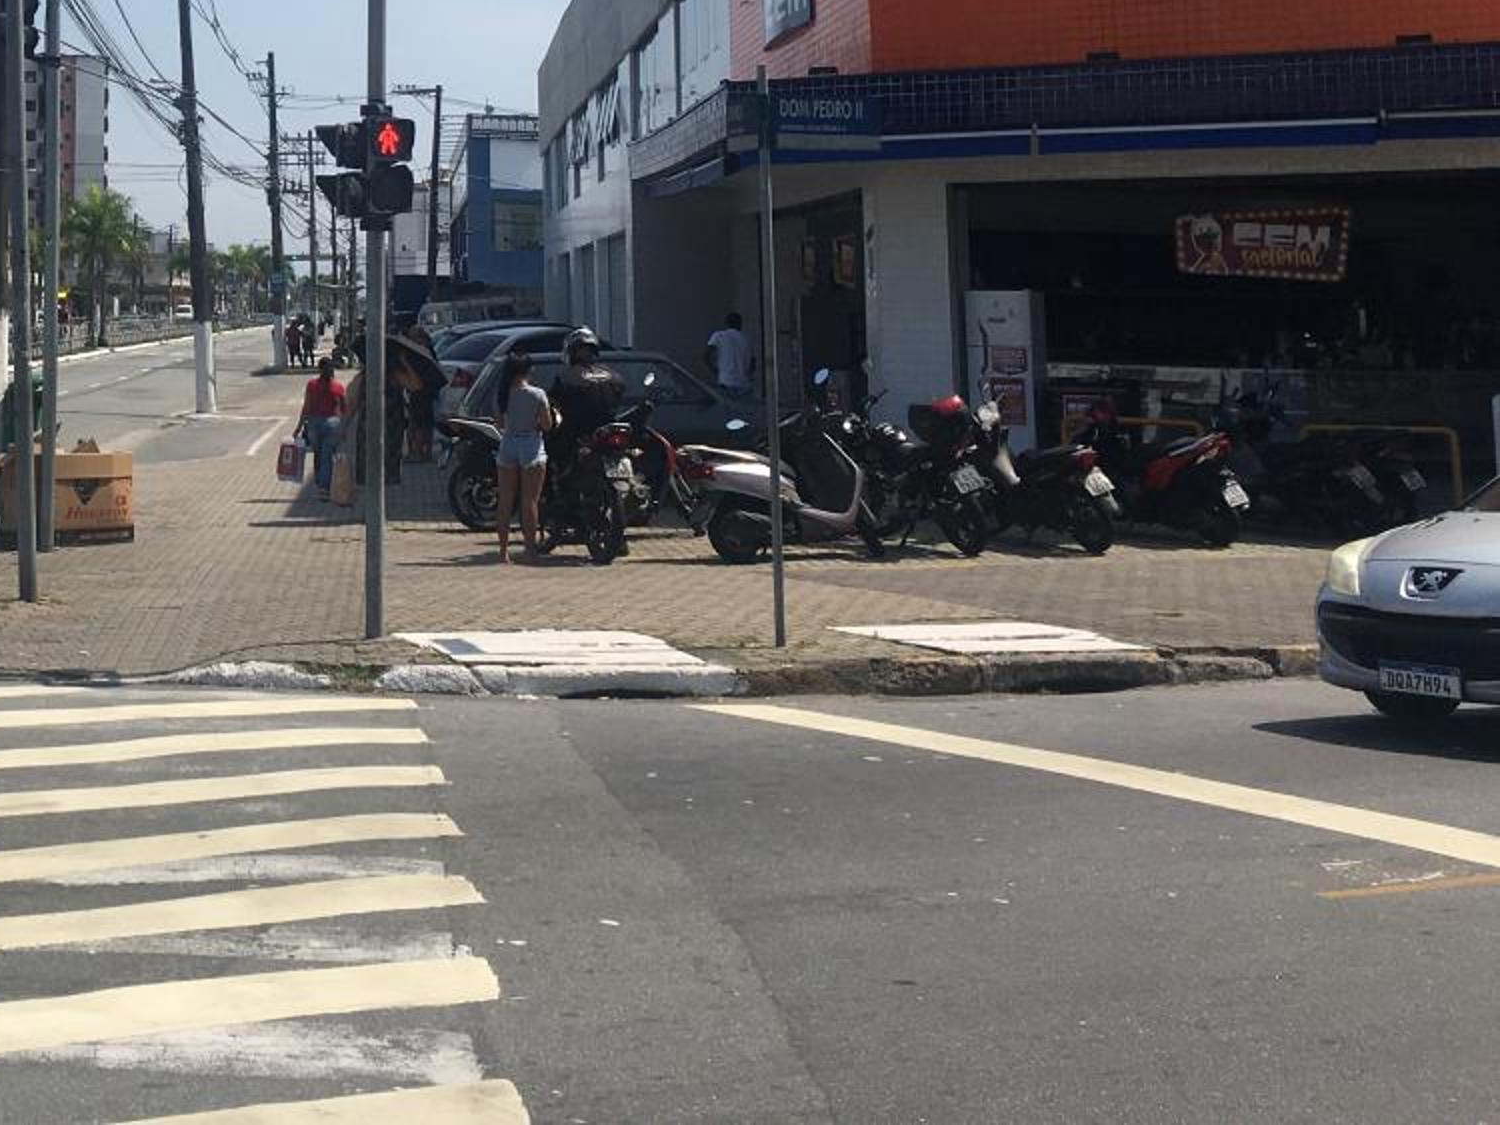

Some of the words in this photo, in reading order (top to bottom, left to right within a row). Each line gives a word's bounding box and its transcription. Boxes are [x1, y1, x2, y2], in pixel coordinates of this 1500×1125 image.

[779, 99, 809, 118] DOM
[813, 100, 851, 119] PEDRO
[1233, 222, 1331, 252] CEM
